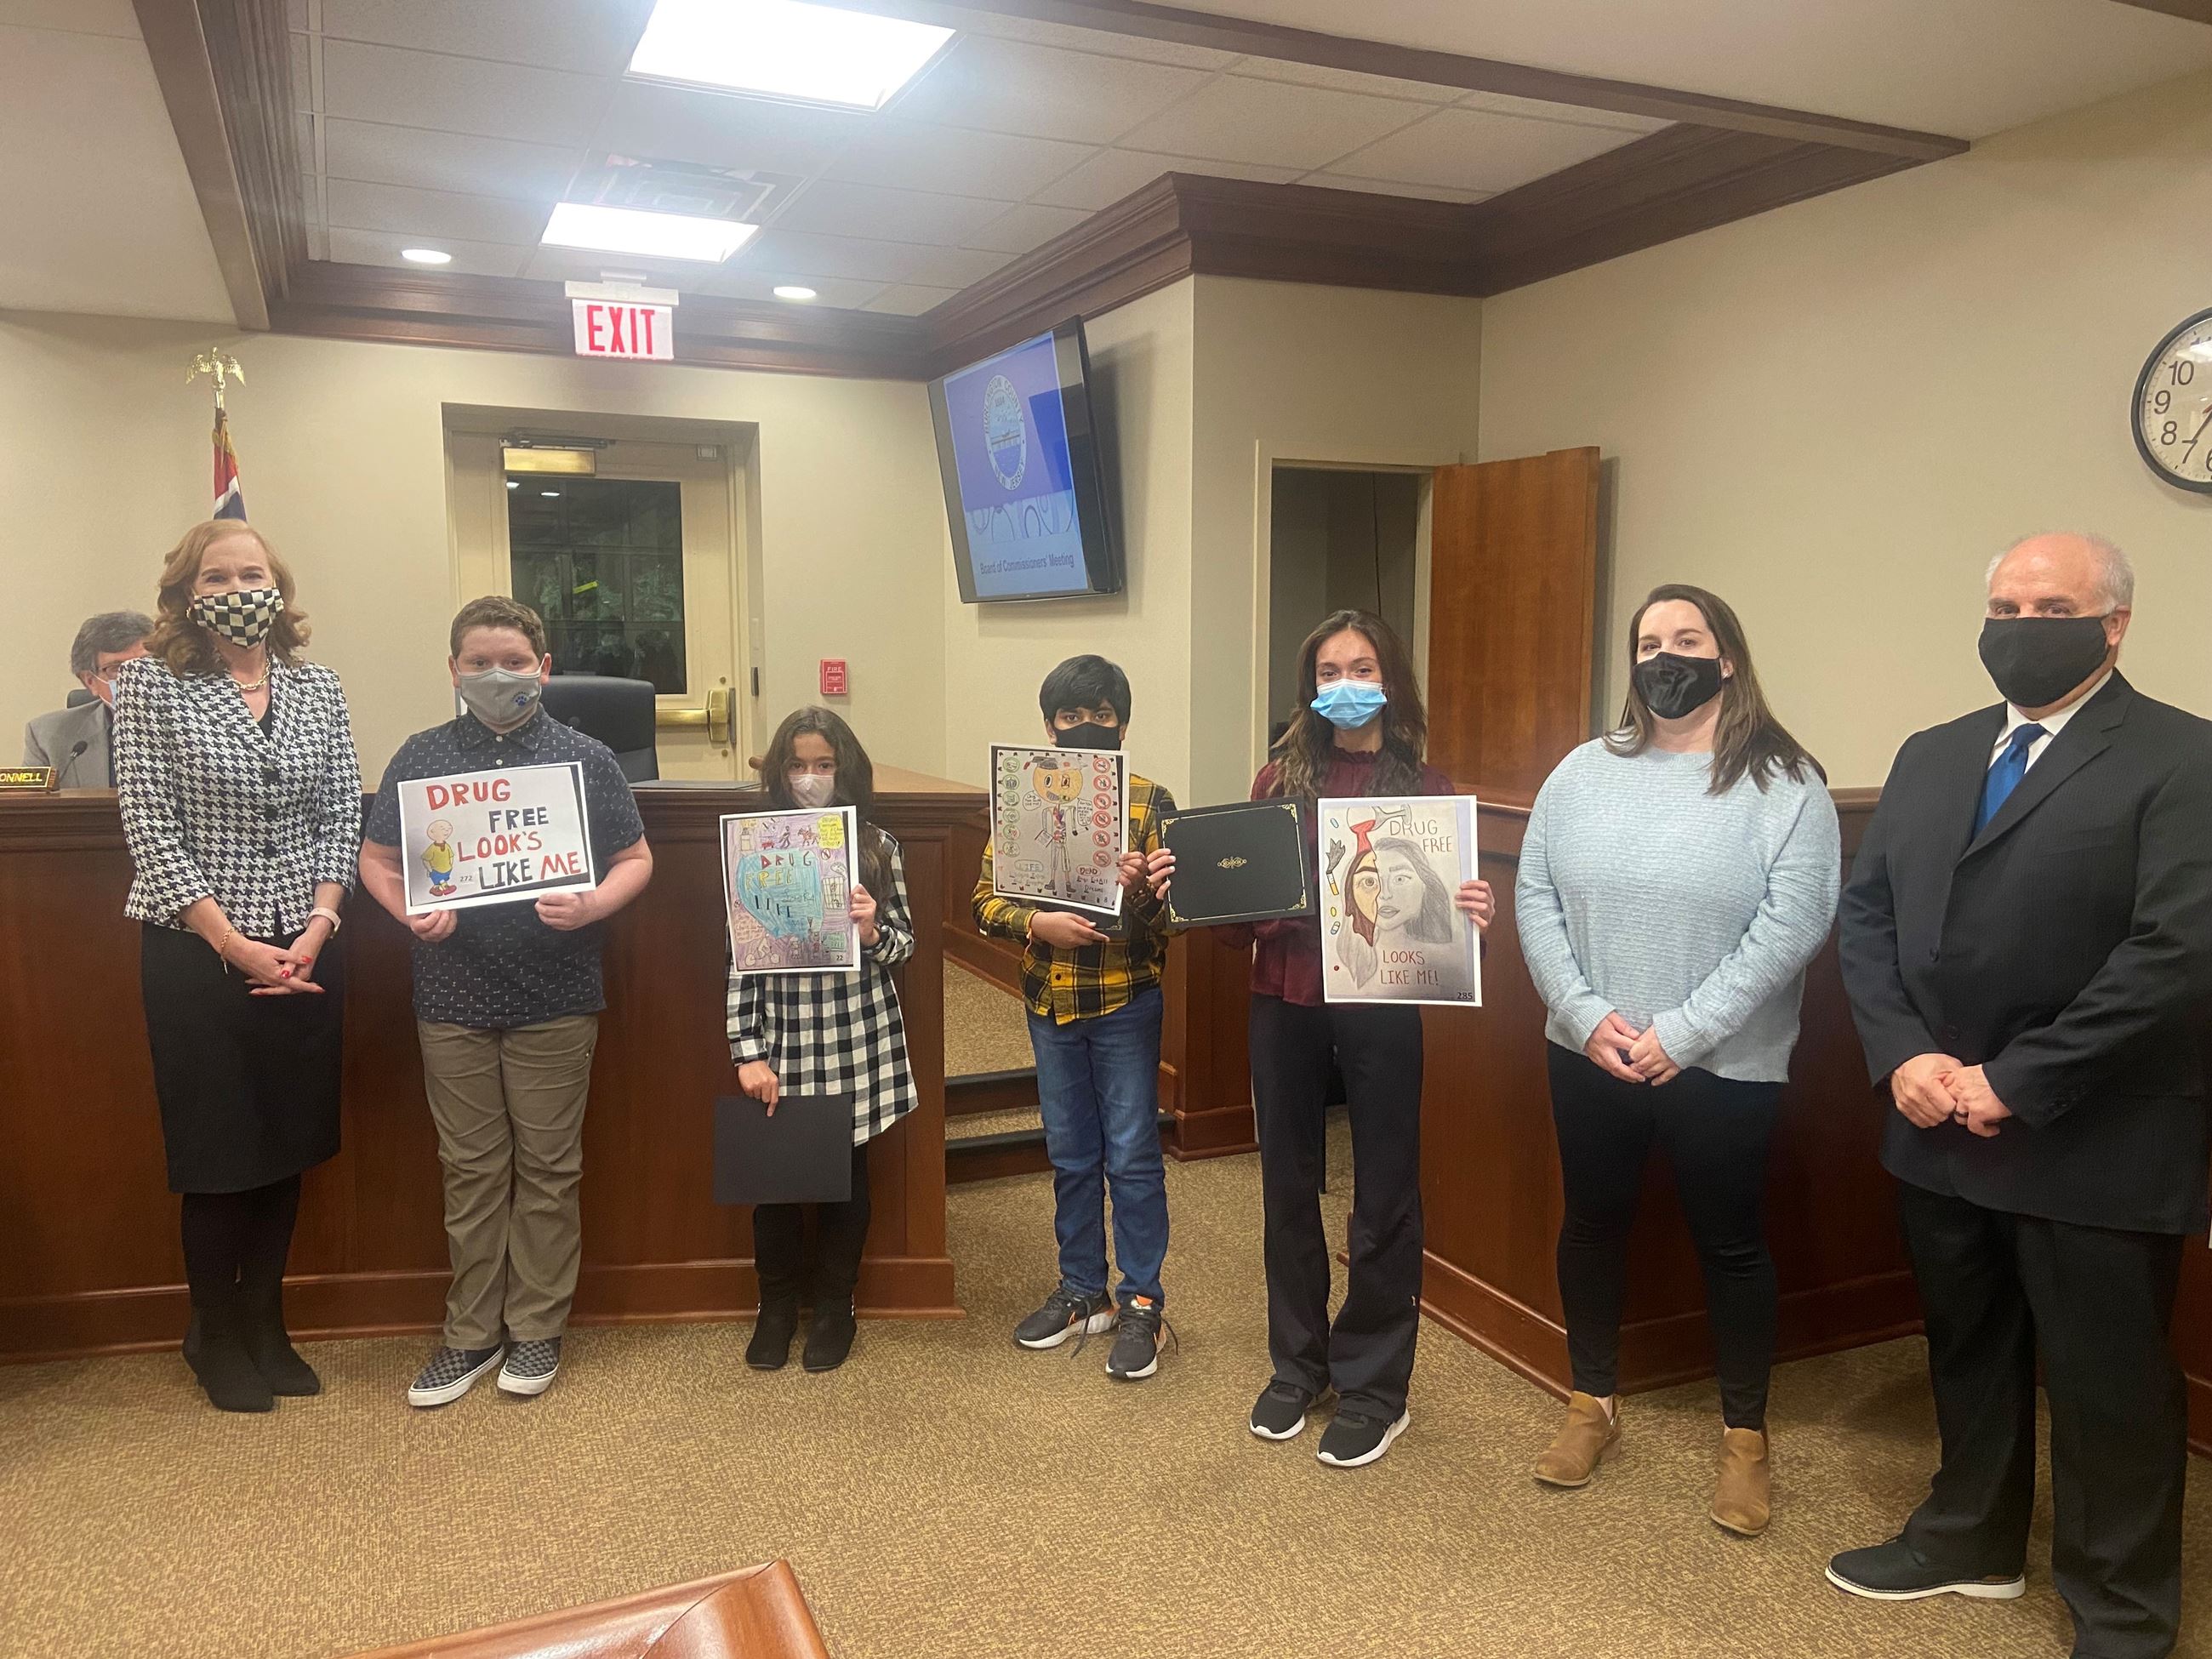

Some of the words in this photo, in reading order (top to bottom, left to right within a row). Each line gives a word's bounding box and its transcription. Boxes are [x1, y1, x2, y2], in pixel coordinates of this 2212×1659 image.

[587, 305, 655, 354] EXIT
[2169, 360, 2195, 385] 10
[2153, 390, 2171, 414] 9
[2160, 420, 2178, 446] 8
[2181, 439, 2198, 464] 7
[980, 562, 996, 574] Board
[997, 560, 1002, 573] of
[1048, 552, 1075, 568] Meeting
[425, 778, 512, 810] DRUG
[488, 807, 550, 834] FREE
[1389, 819, 1438, 836] DRUG
[457, 831, 543, 862] LOOK'S
[1422, 836, 1452, 853] FREE
[478, 858, 533, 891] LIKE
[540, 851, 582, 881] ME
[760, 851, 812, 869] DRUG
[745, 869, 794, 891] FREE
[1382, 950, 1425, 964] LOOKS
[1381, 969, 1410, 984] LIKE
[1417, 970, 1440, 986] ME!
[1457, 992, 1473, 1001] 285
